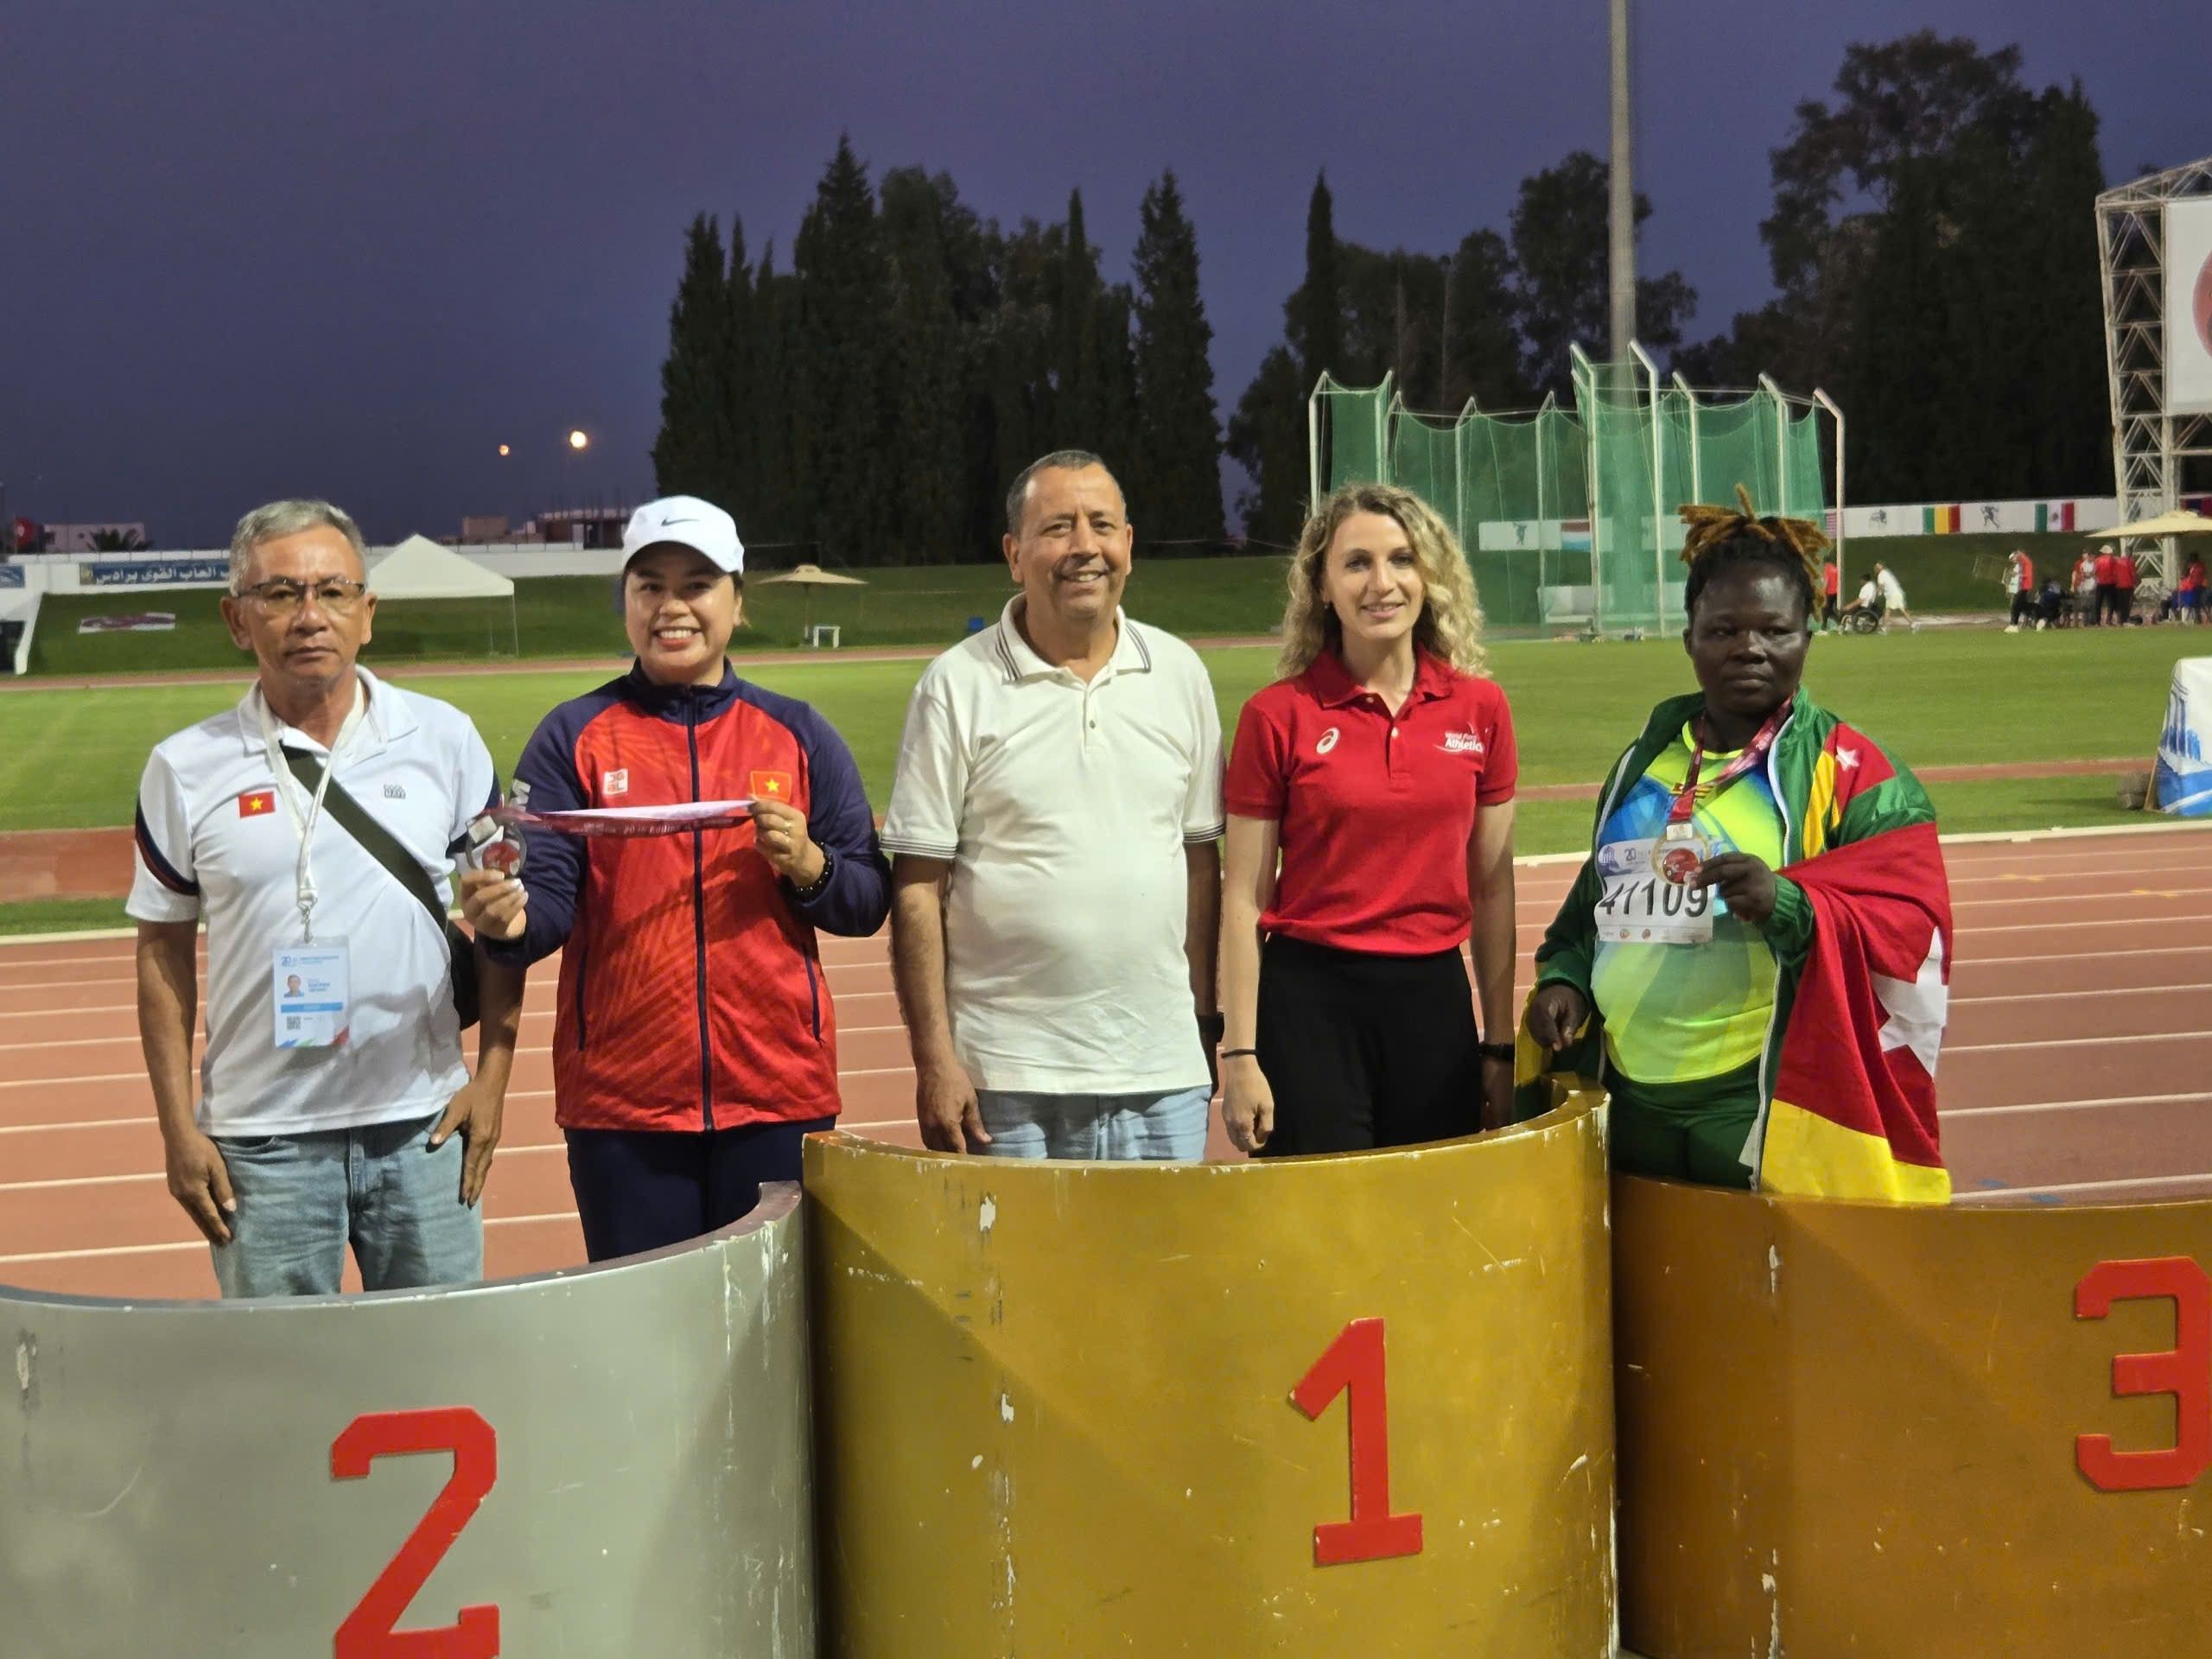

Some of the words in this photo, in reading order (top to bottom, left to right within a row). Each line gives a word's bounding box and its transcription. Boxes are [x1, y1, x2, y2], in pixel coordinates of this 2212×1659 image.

[1287, 1317, 1423, 1567] 1
[2075, 1256, 2212, 1491] 3
[331, 1405, 499, 1659] 2
